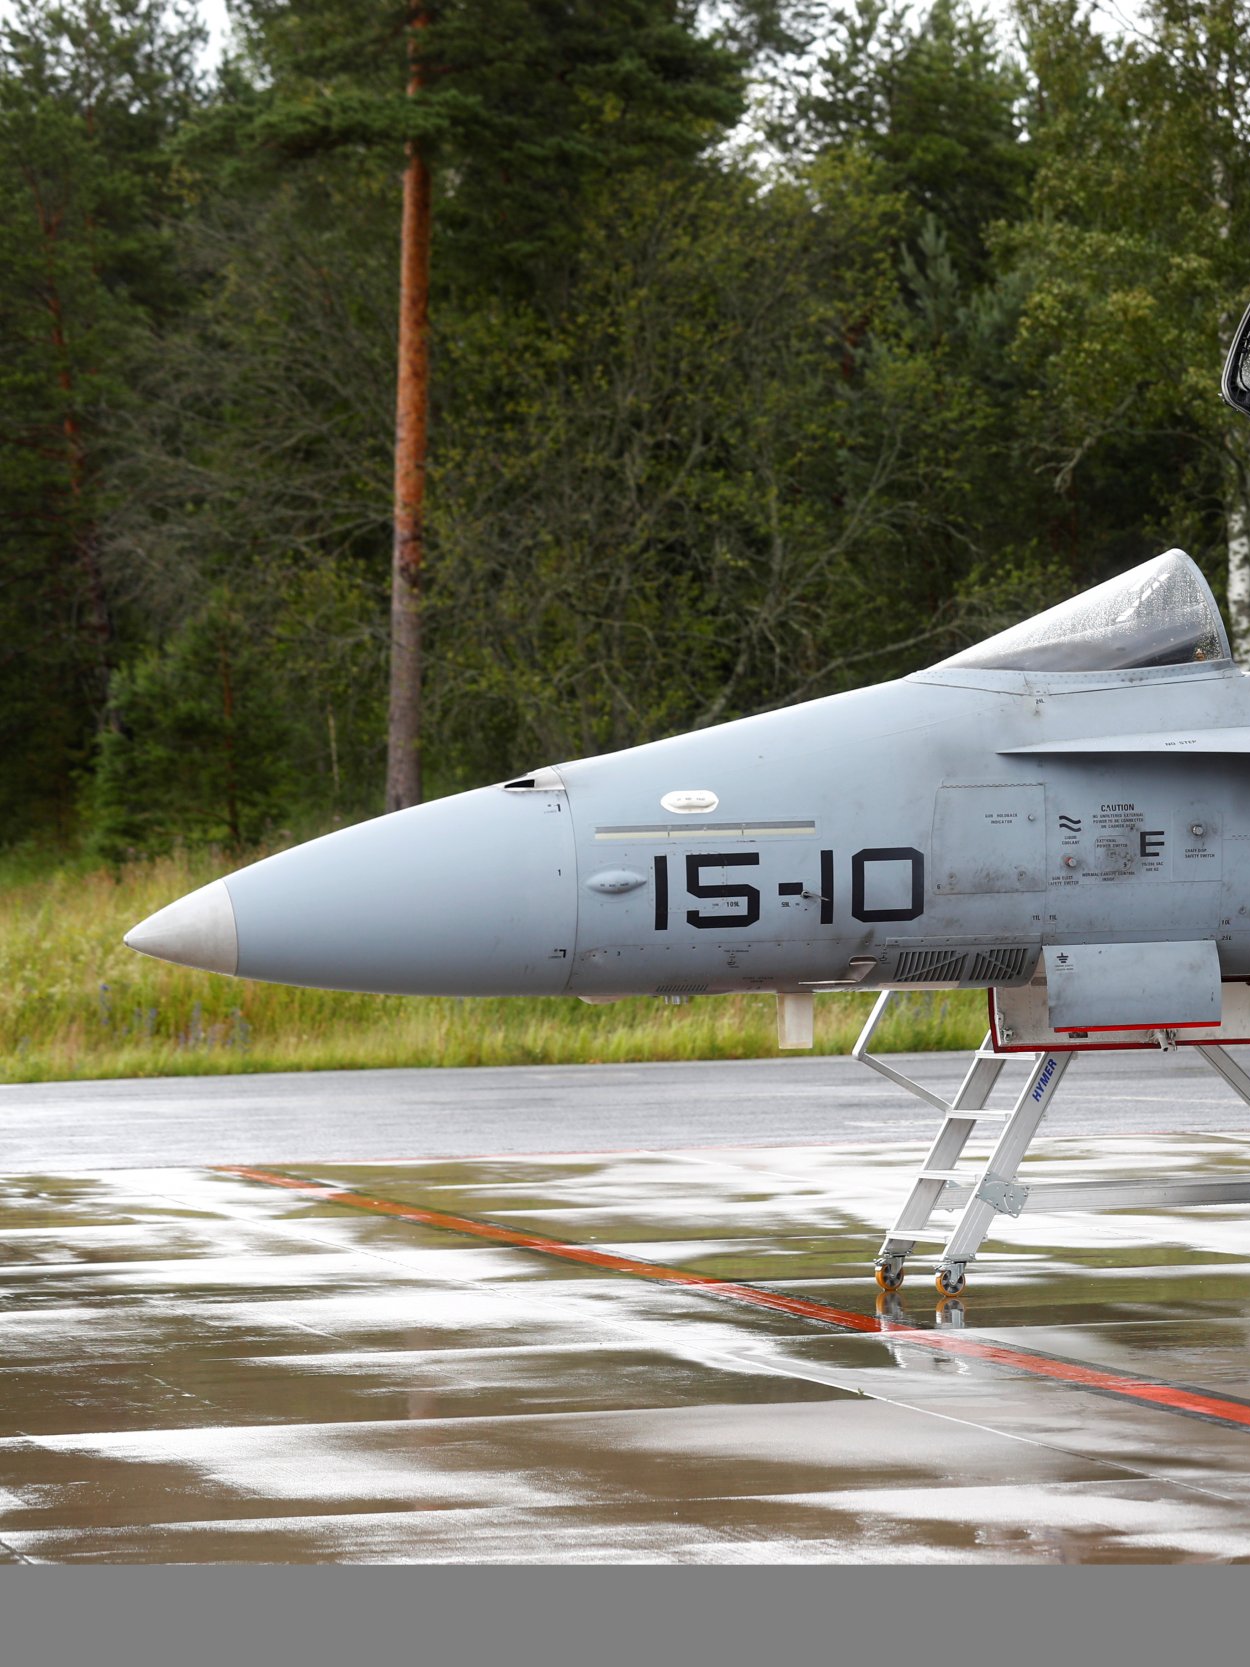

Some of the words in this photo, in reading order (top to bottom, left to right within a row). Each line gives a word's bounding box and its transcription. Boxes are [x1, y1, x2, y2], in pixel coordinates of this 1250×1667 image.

[1101, 803, 1135, 812] CAUTION
[1140, 830, 1165, 857] E
[654, 846, 925, 931] 15-10
[1031, 1058, 1058, 1103] HYMER
